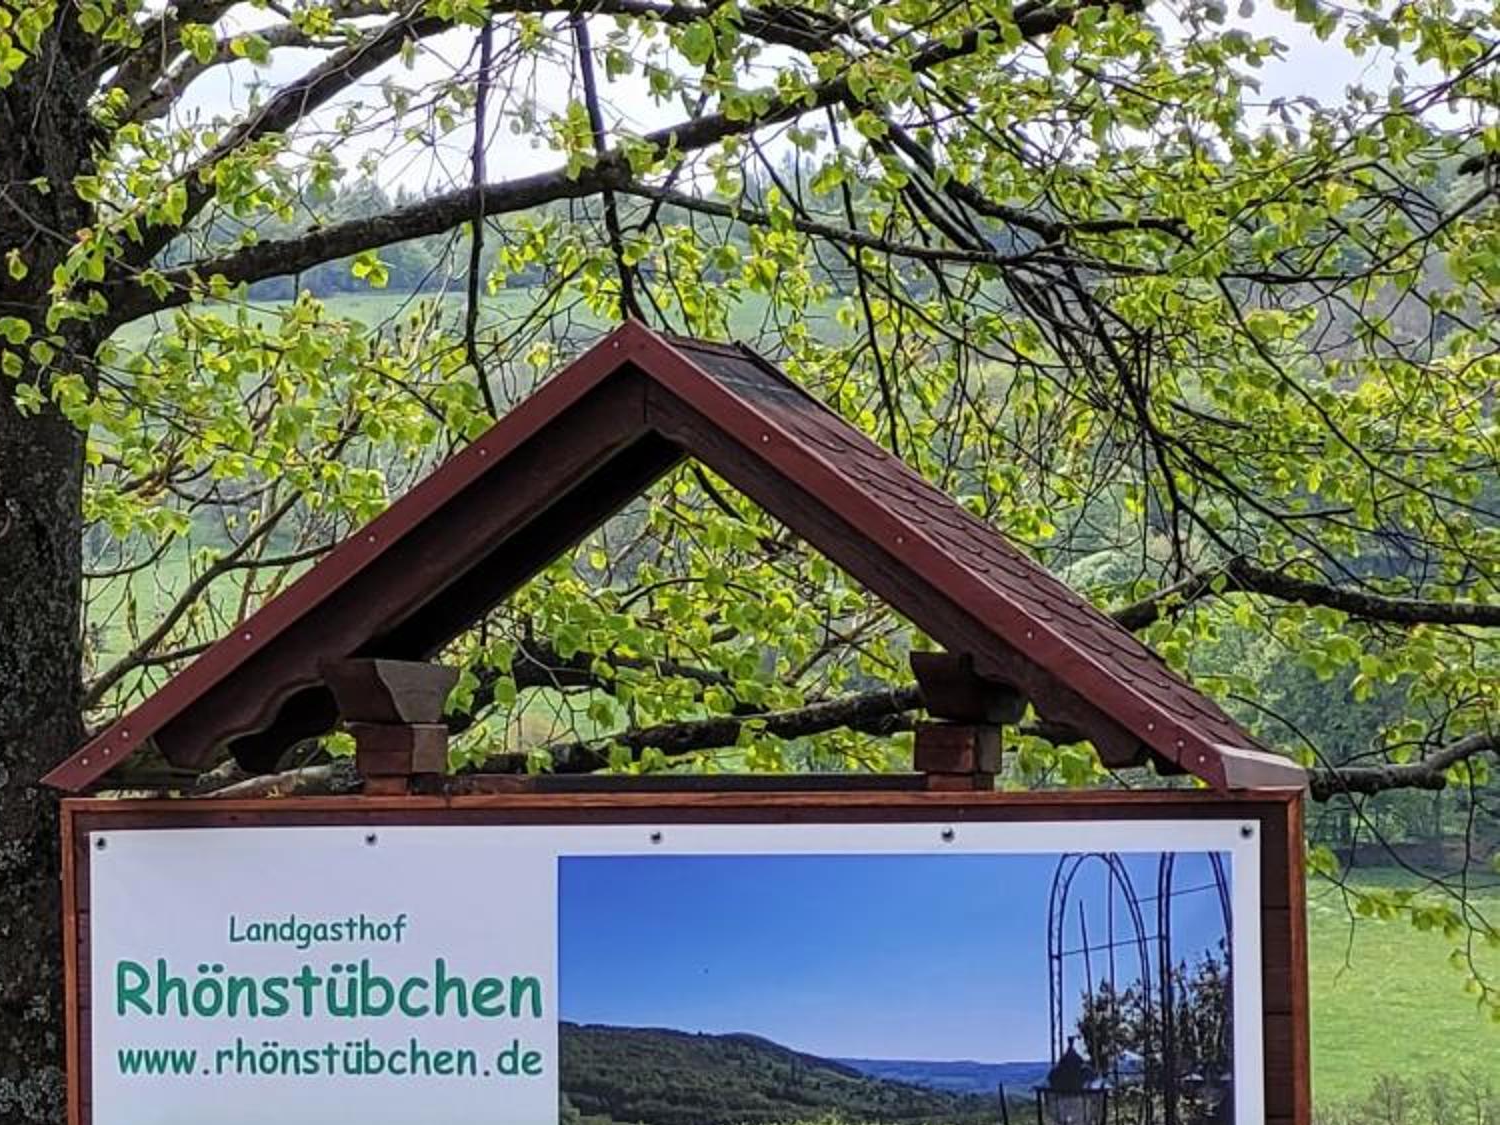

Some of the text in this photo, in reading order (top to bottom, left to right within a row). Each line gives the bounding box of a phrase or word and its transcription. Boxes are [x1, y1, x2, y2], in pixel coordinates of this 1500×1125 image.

[229, 913, 407, 949] Landgasthof
[115, 957, 543, 1018] Rhönstübchen
[118, 1037, 543, 1077] www.rhönstübchen.de
